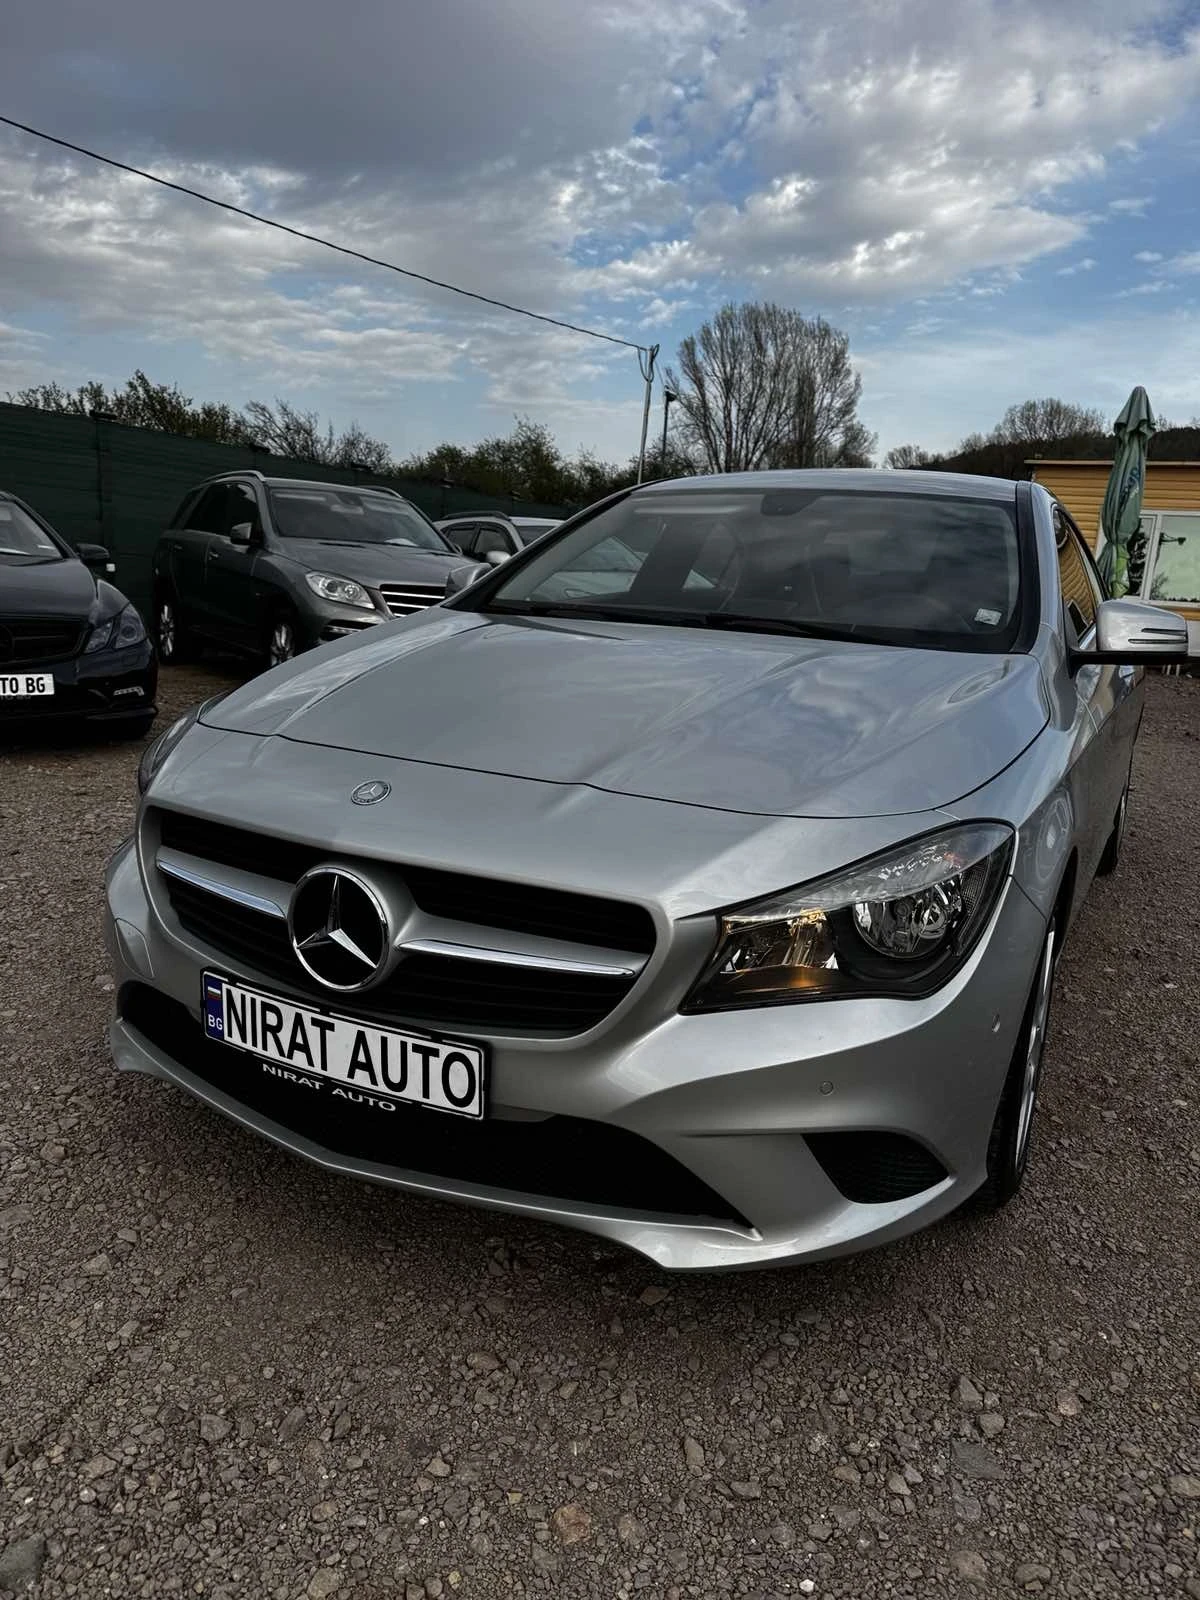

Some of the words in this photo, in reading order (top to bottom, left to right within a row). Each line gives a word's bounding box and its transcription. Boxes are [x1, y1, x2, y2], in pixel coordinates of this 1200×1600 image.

[25, 677, 46, 694] BG
[208, 1014, 223, 1031] BG
[225, 987, 336, 1073] NIRAT
[346, 1029, 477, 1108] AUTO
[262, 1063, 325, 1090] NIRAT
[331, 1087, 397, 1112] AUTO
